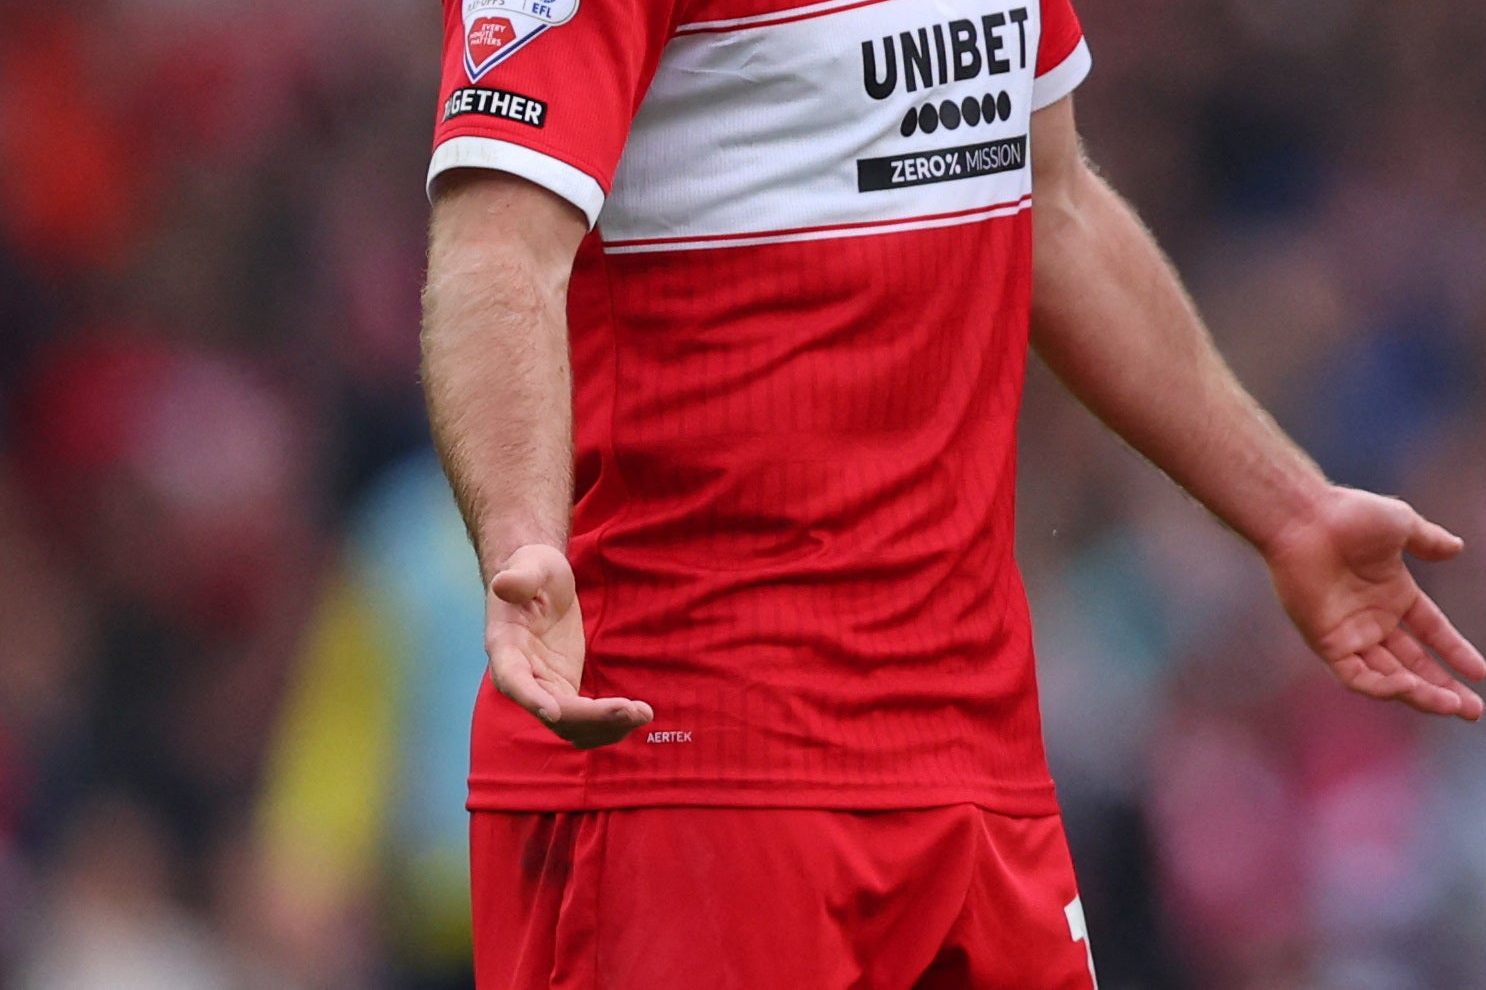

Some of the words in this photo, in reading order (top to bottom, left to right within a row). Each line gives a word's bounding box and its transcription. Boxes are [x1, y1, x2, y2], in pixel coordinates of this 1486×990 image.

[531, 2, 552, 19] EFL
[861, 7, 1029, 100] UNIBET
[442, 88, 542, 125] GETHER
[891, 152, 961, 183] ZERO%
[965, 142, 1021, 172] MISSION
[646, 731, 692, 744] AERTEK
